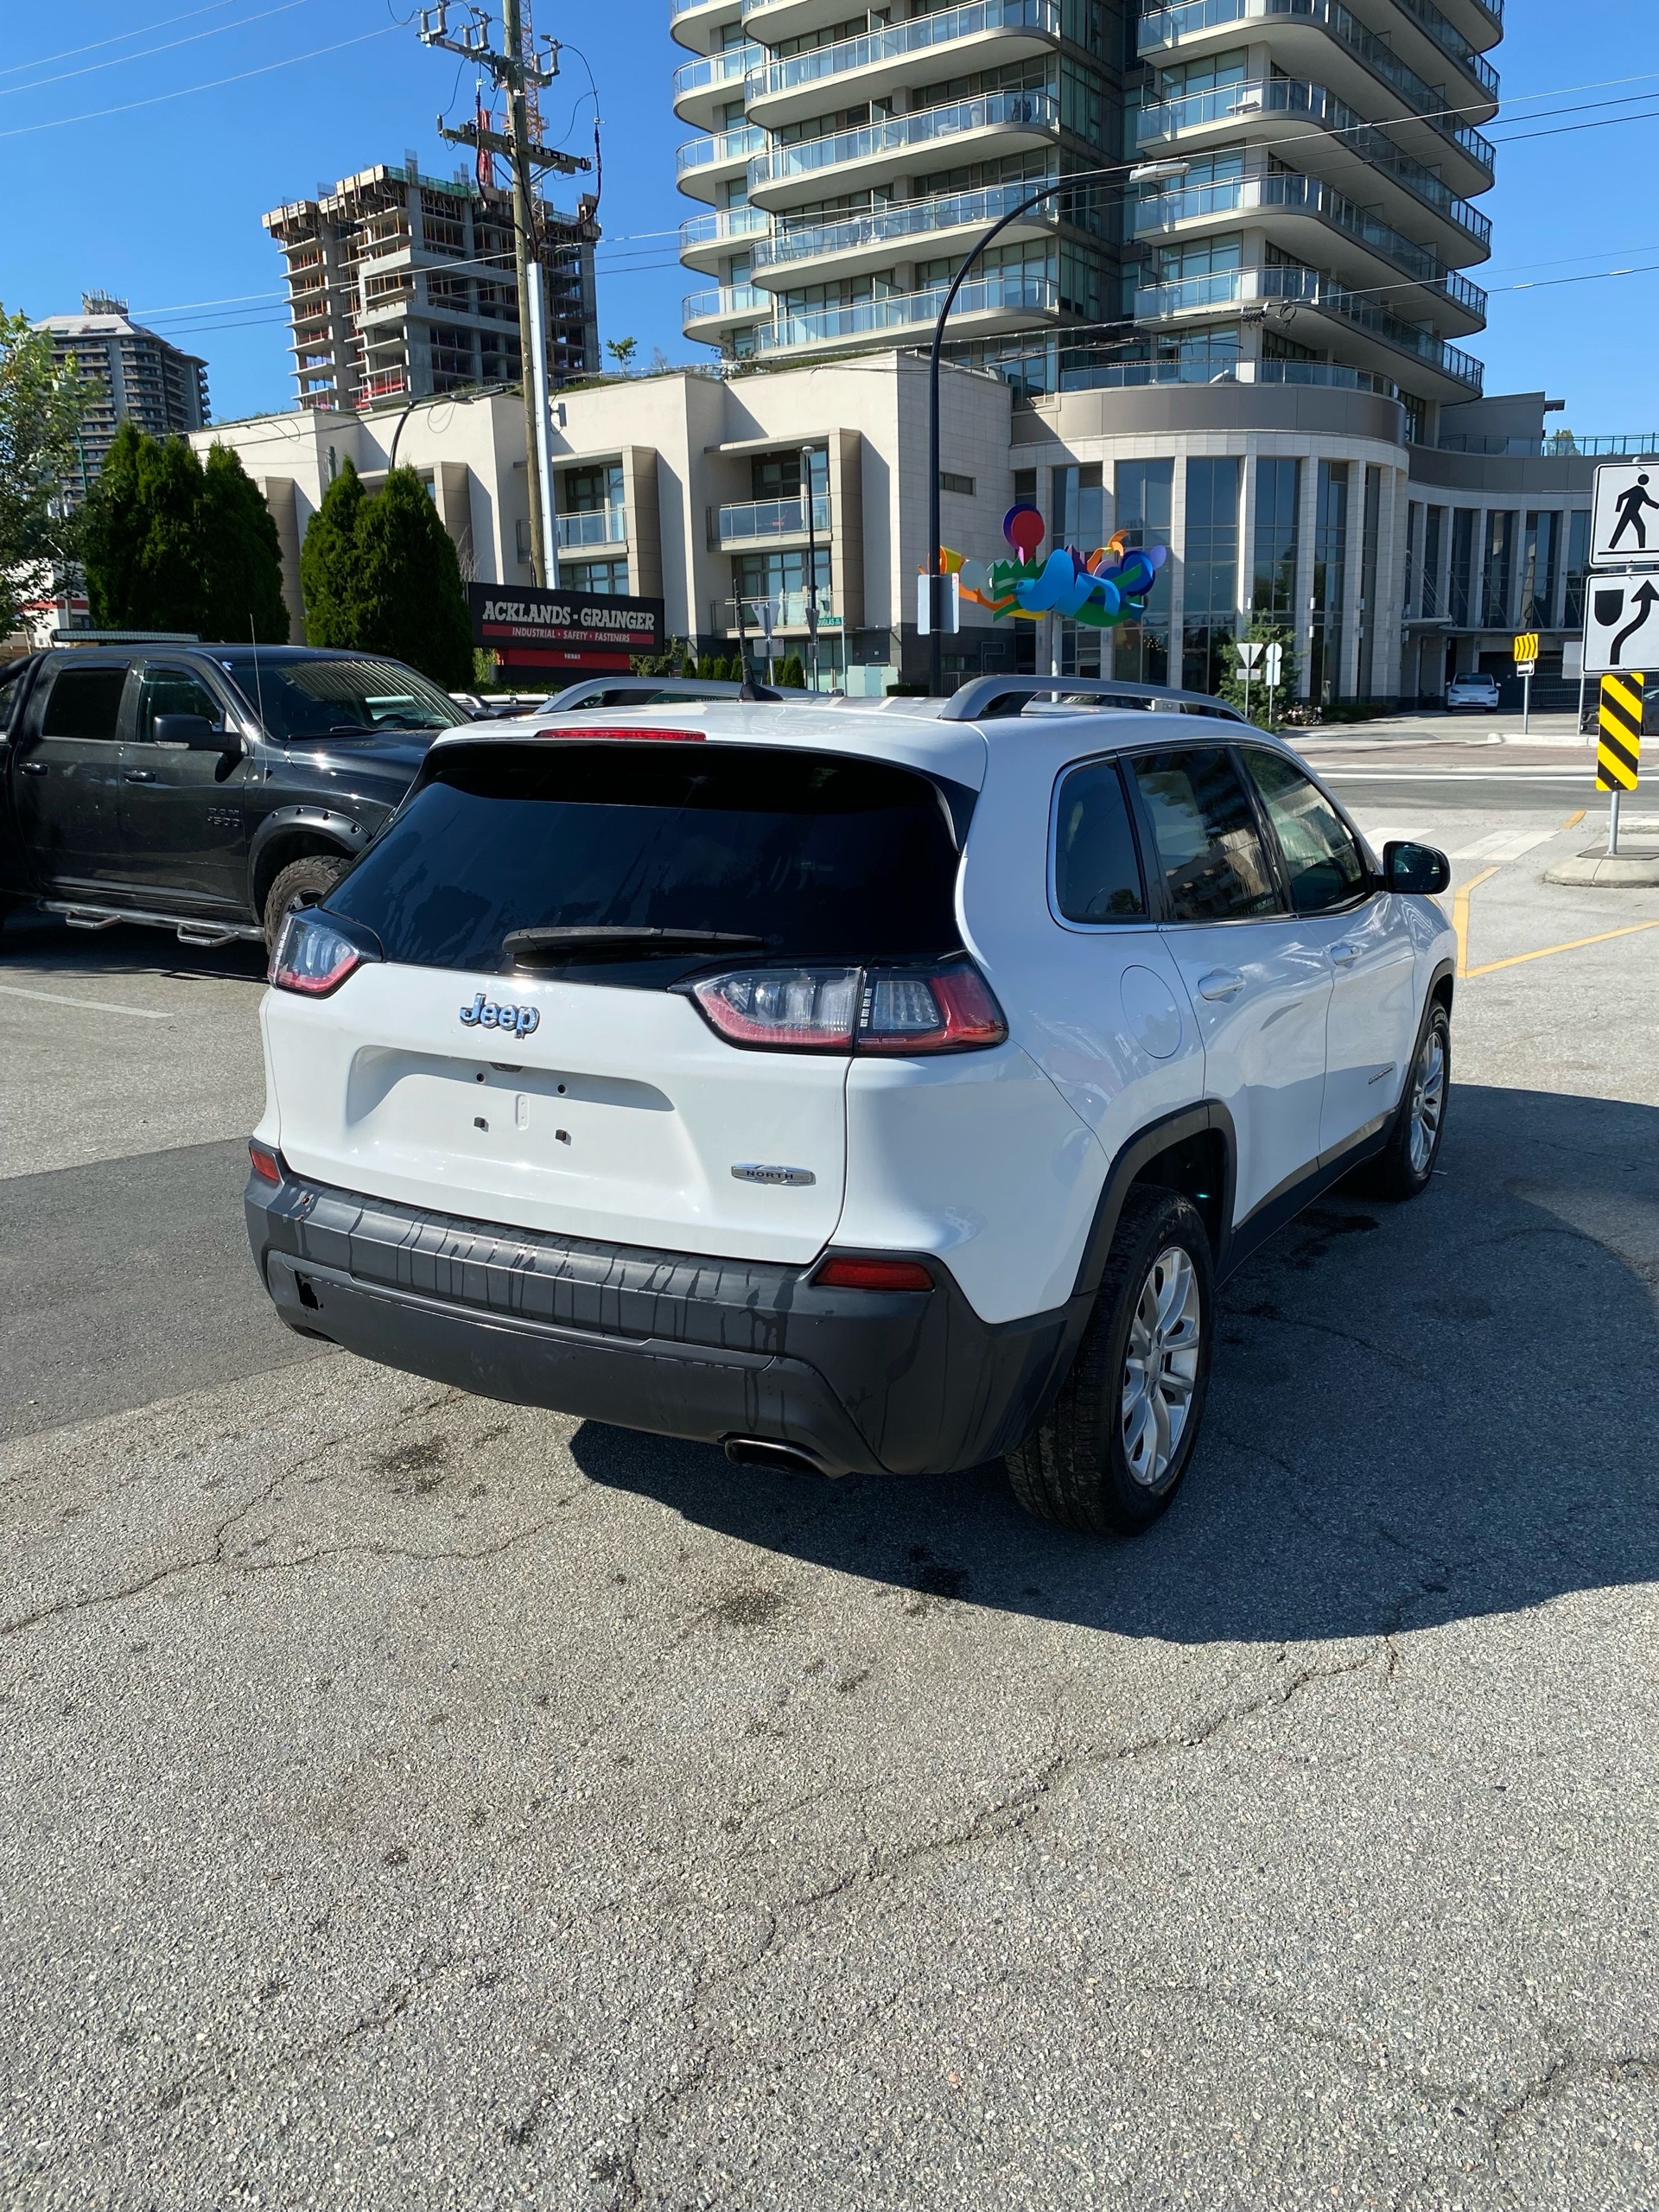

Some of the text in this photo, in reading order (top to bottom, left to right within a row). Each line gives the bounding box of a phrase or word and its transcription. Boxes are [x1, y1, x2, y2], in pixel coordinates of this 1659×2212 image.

[512, 626, 630, 643] INDUSTRIAL SAFETY FASTENERS
[460, 993, 540, 1039] Jeep
[746, 1170, 793, 1179] NORTH
